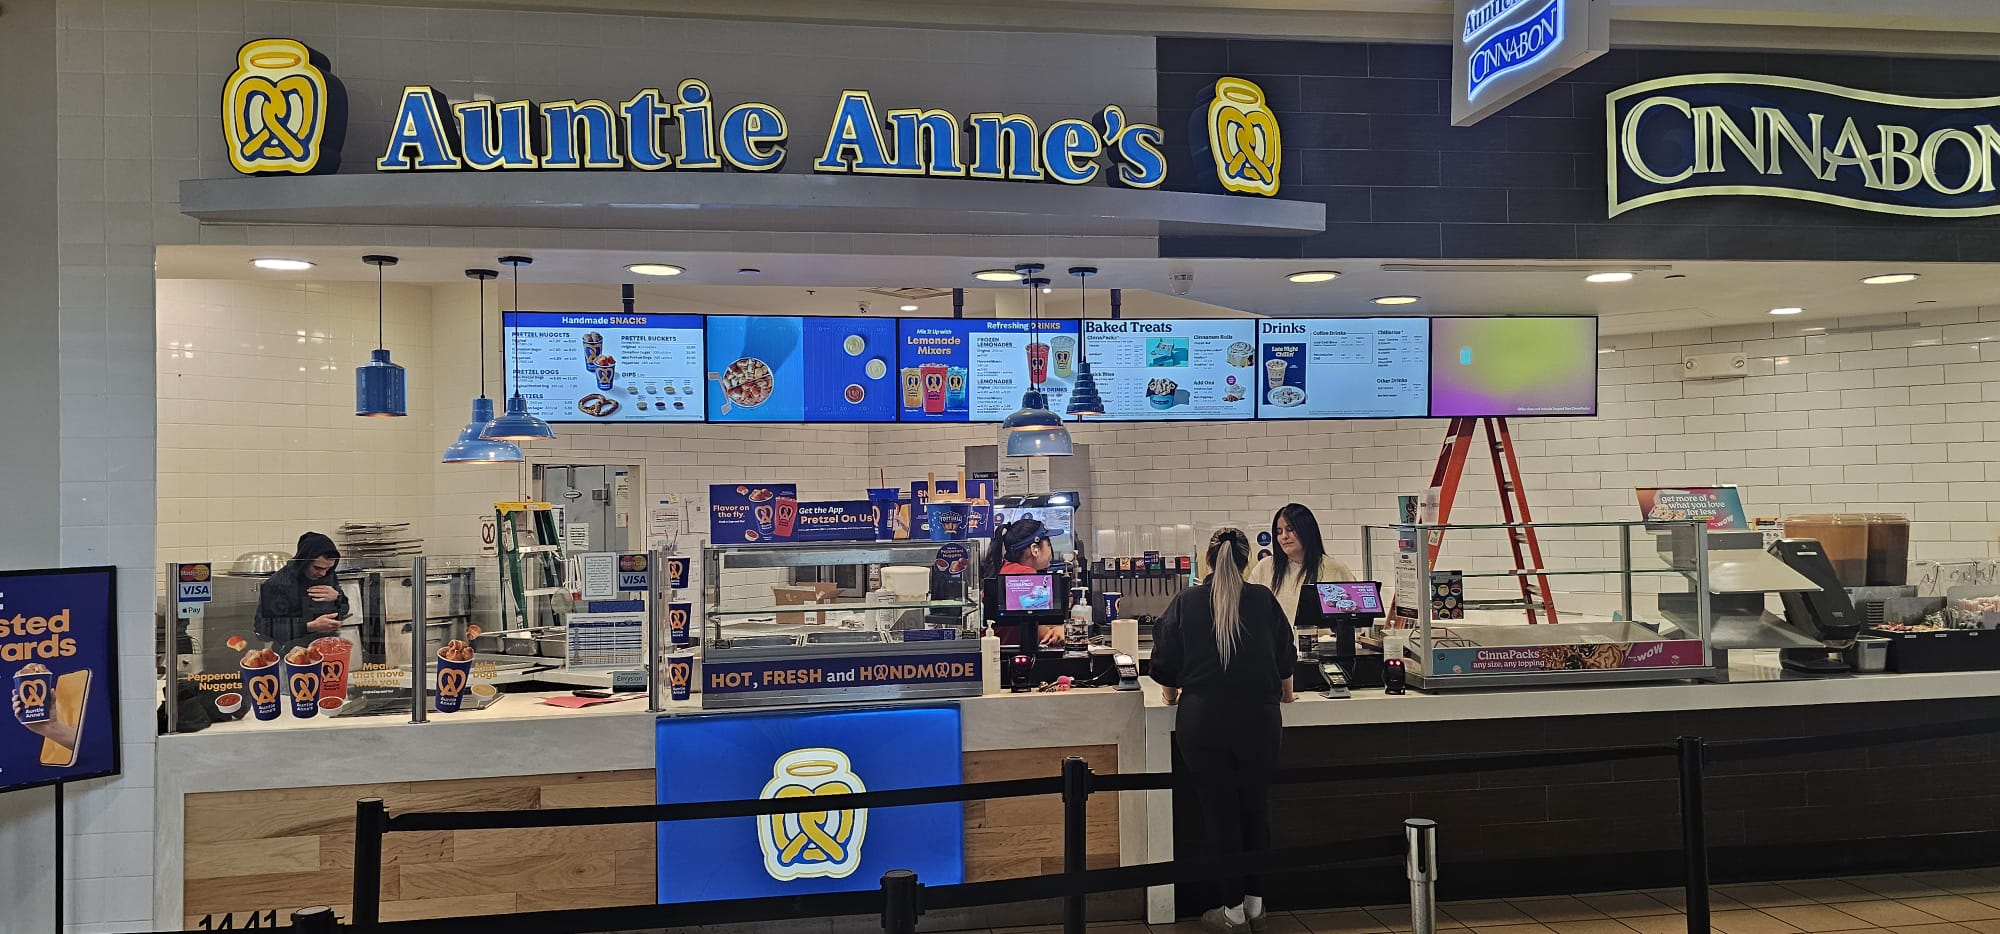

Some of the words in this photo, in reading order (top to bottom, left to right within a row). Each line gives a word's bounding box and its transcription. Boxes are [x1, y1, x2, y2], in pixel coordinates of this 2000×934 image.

[1471, 9, 1555, 83] CINNABON
[377, 79, 788, 171] Auntie
[814, 89, 1168, 188] Anne's
[562, 316, 608, 325] Handmade
[609, 316, 648, 325] SNACKS
[987, 322, 1029, 331] Refreshing
[1086, 321, 1128, 333] Baked
[1130, 321, 1172, 333] Treats
[1262, 323, 1306, 334] Drinks
[907, 336, 961, 345] Lemonade
[917, 346, 952, 355] Mixers
[917, 489, 950, 498] SNCK
[1661, 494, 1674, 503] get
[828, 507, 844, 515] App
[1686, 508, 1698, 516] for
[800, 515, 838, 524] Pretzel
[841, 514, 857, 523] On
[623, 575, 646, 584] VISA
[184, 585, 209, 595] VISA
[0, 633, 77, 662] ards
[1636, 643, 1663, 661] WOW
[1478, 649, 1540, 660] CinnaPacks
[475, 661, 496, 670] Mini
[187, 671, 241, 682] Pepperoni
[352, 671, 375, 679] that
[376, 670, 404, 678] move
[473, 671, 497, 679] Dogs
[711, 672, 758, 688] HOT,
[763, 668, 822, 685] FRESH
[826, 668, 855, 682] and
[199, 682, 243, 692] Nuggets
[355, 679, 377, 687] with
